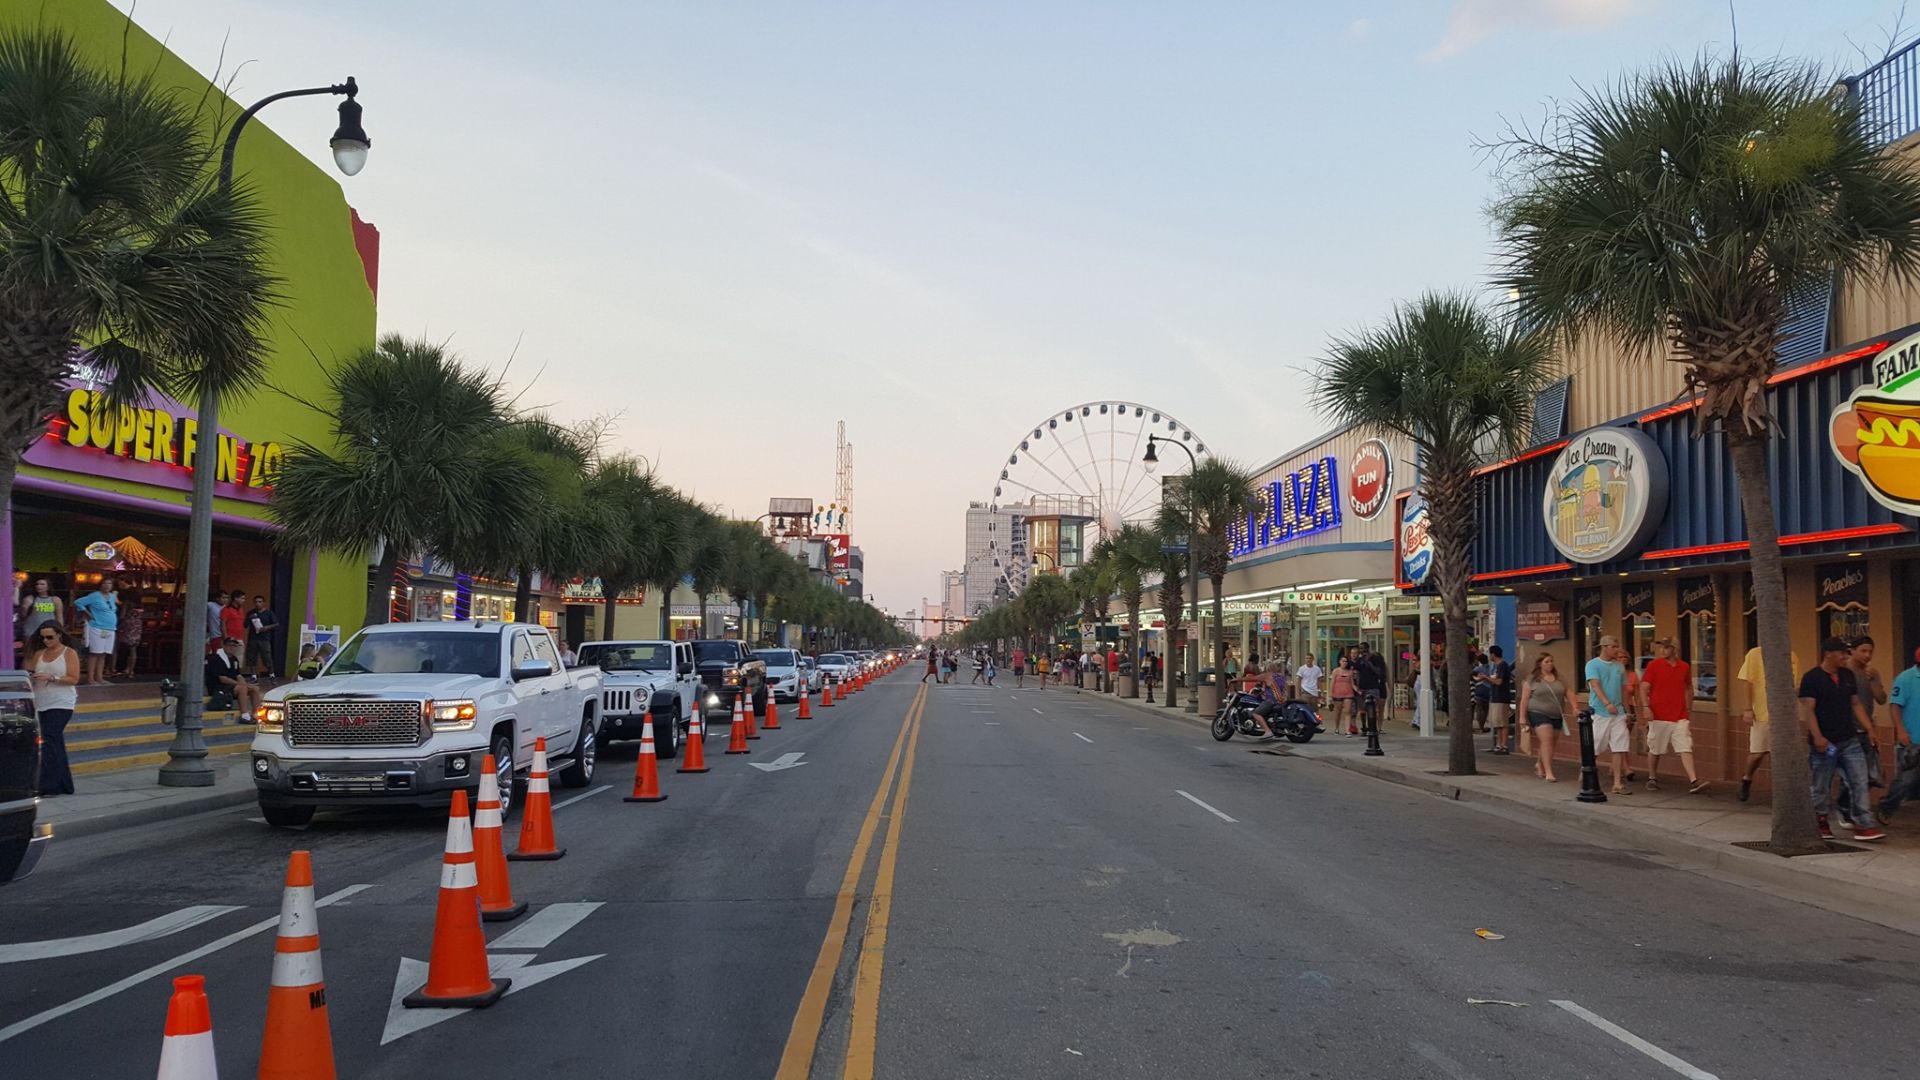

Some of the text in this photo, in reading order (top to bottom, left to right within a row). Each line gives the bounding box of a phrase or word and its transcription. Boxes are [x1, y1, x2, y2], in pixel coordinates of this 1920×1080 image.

[1876, 342, 1920, 389] FAM
[67, 388, 284, 488] SUPER FN ZO
[1351, 445, 1382, 473] FAMILY
[1565, 449, 1580, 473] Ice
[1583, 436, 1617, 463] Cream
[1357, 471, 1377, 488] FUN
[1256, 456, 1341, 547] PLAZA
[1351, 485, 1384, 514] CENTER
[1299, 592, 1348, 601] BOWLING
[1822, 569, 1863, 596] Peaches
[1892, 687, 1900, 697] 3
[326, 715, 379, 728] GMC
